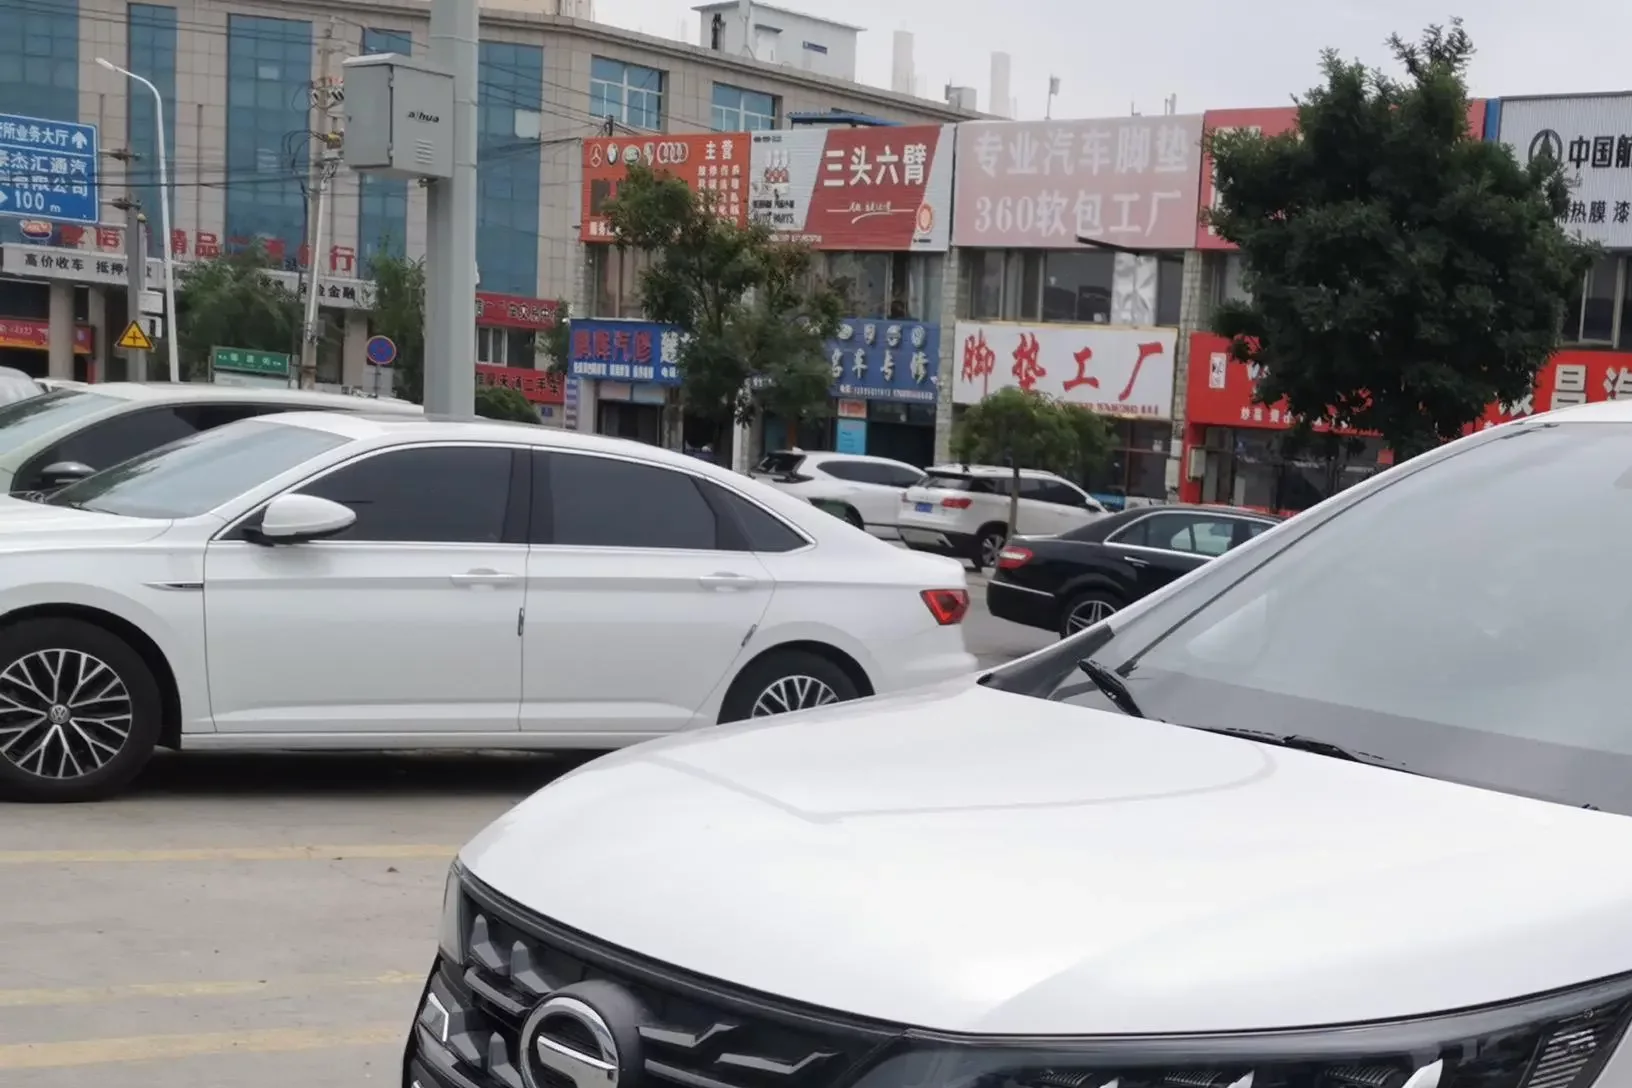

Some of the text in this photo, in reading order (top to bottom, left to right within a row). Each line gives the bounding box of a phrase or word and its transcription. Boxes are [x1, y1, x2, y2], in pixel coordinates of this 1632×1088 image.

[0, 122, 69, 147] 所业务大厅
[705, 140, 733, 160] 主营
[974, 124, 1190, 177] 专业汽车脚垫
[824, 143, 927, 187] 三头六臂
[15, 190, 61, 213] 100 m
[974, 190, 1182, 238] 360软包工厂
[25, 253, 84, 272] 高价收车
[962, 328, 1164, 401] 脚垫工厂
